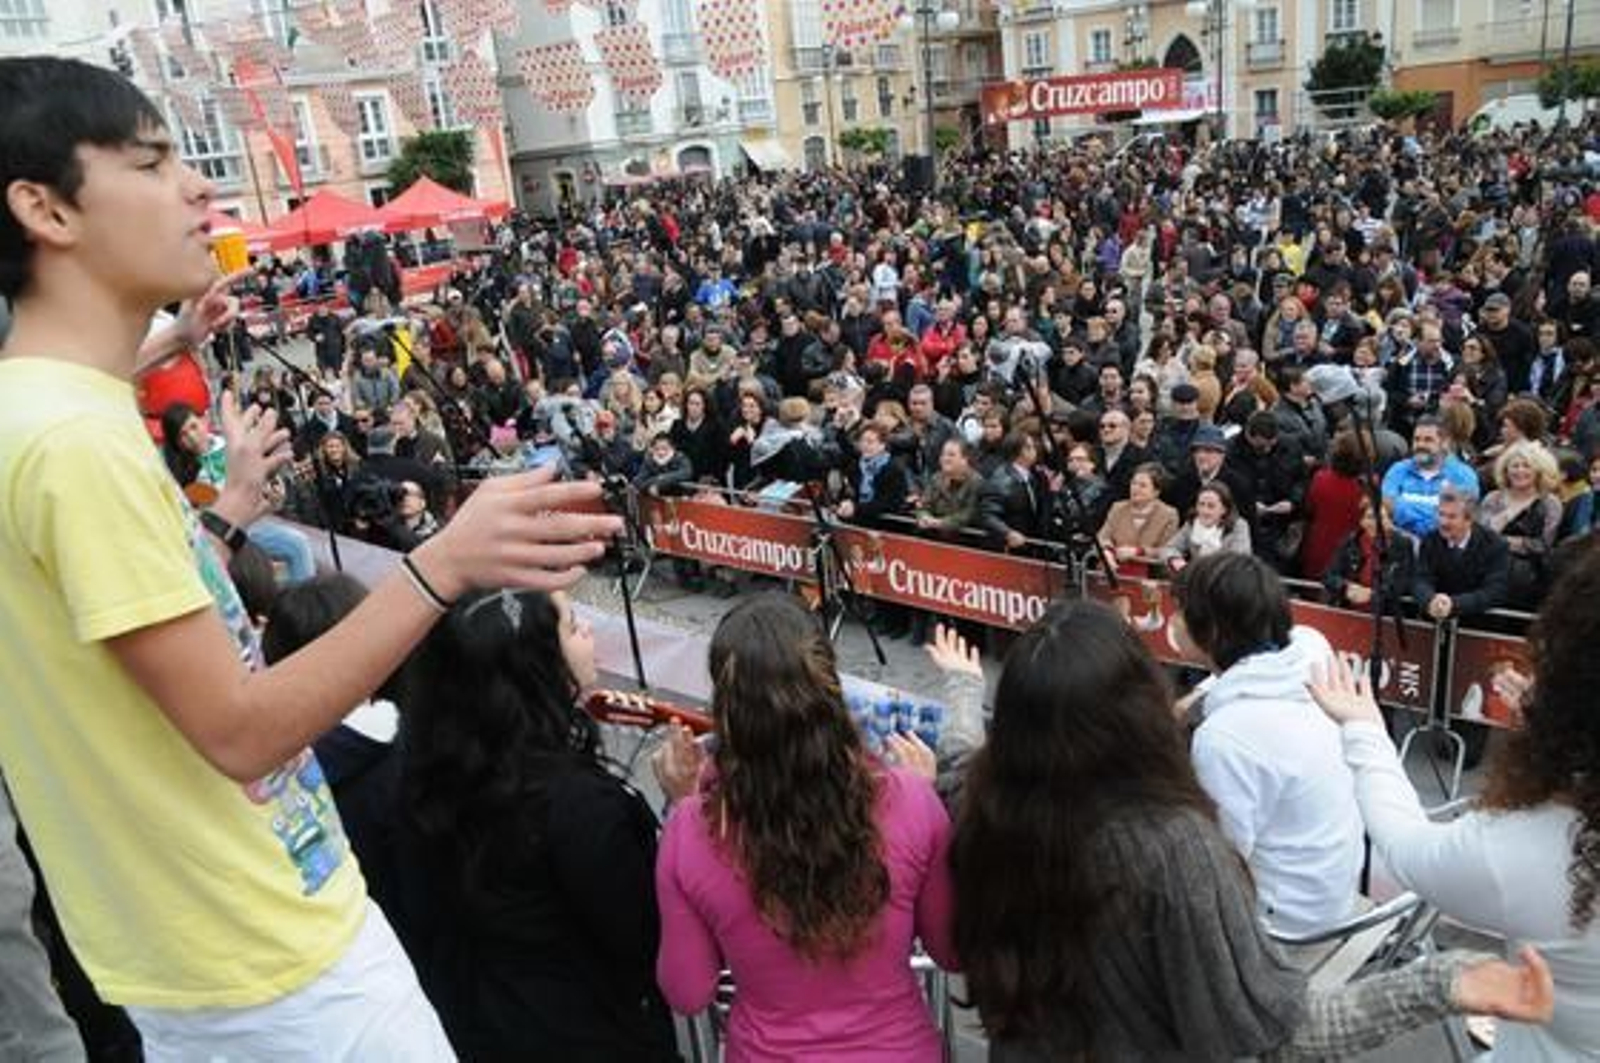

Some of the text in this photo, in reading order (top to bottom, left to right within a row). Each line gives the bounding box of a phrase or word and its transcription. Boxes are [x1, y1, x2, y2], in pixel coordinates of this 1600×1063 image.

[1031, 77, 1165, 112] Cruzcampo
[681, 521, 802, 571] Cruzcampo
[888, 558, 1046, 624] Cruzcampo
